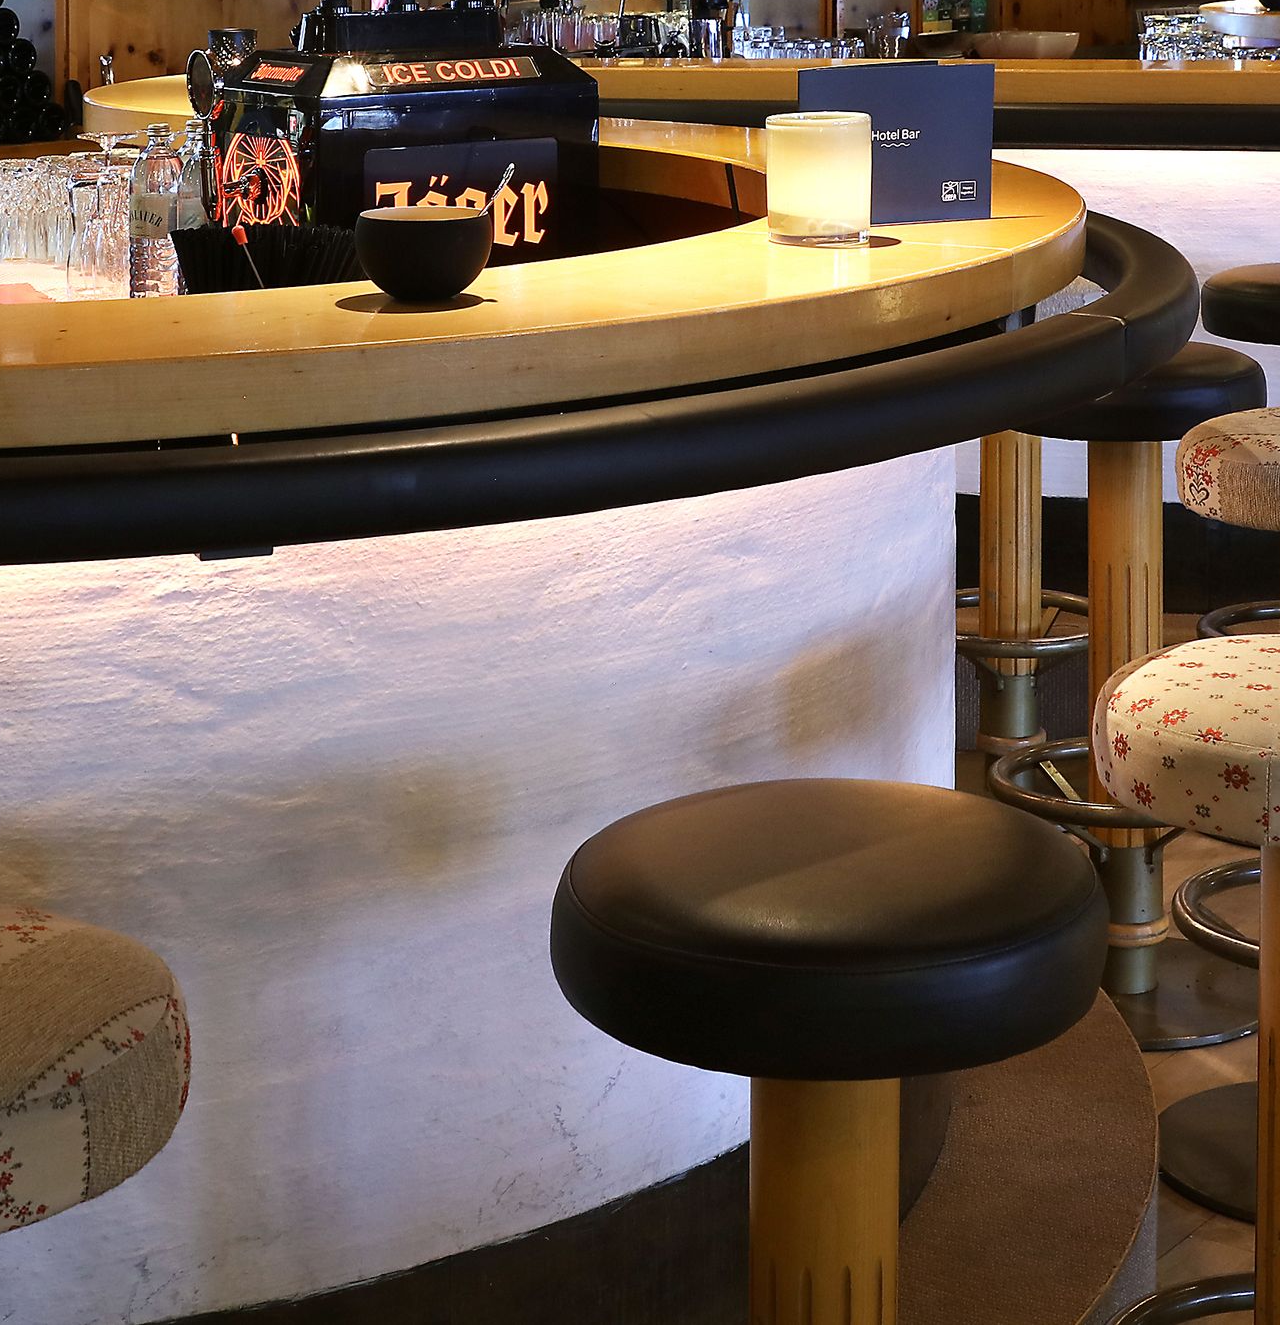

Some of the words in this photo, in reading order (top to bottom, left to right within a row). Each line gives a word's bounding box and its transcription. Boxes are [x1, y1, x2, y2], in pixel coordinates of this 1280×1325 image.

[383, 62, 432, 84] ICE
[443, 58, 521, 80] COLD!
[871, 128, 900, 141] Hotel
[901, 128, 920, 140] Bar
